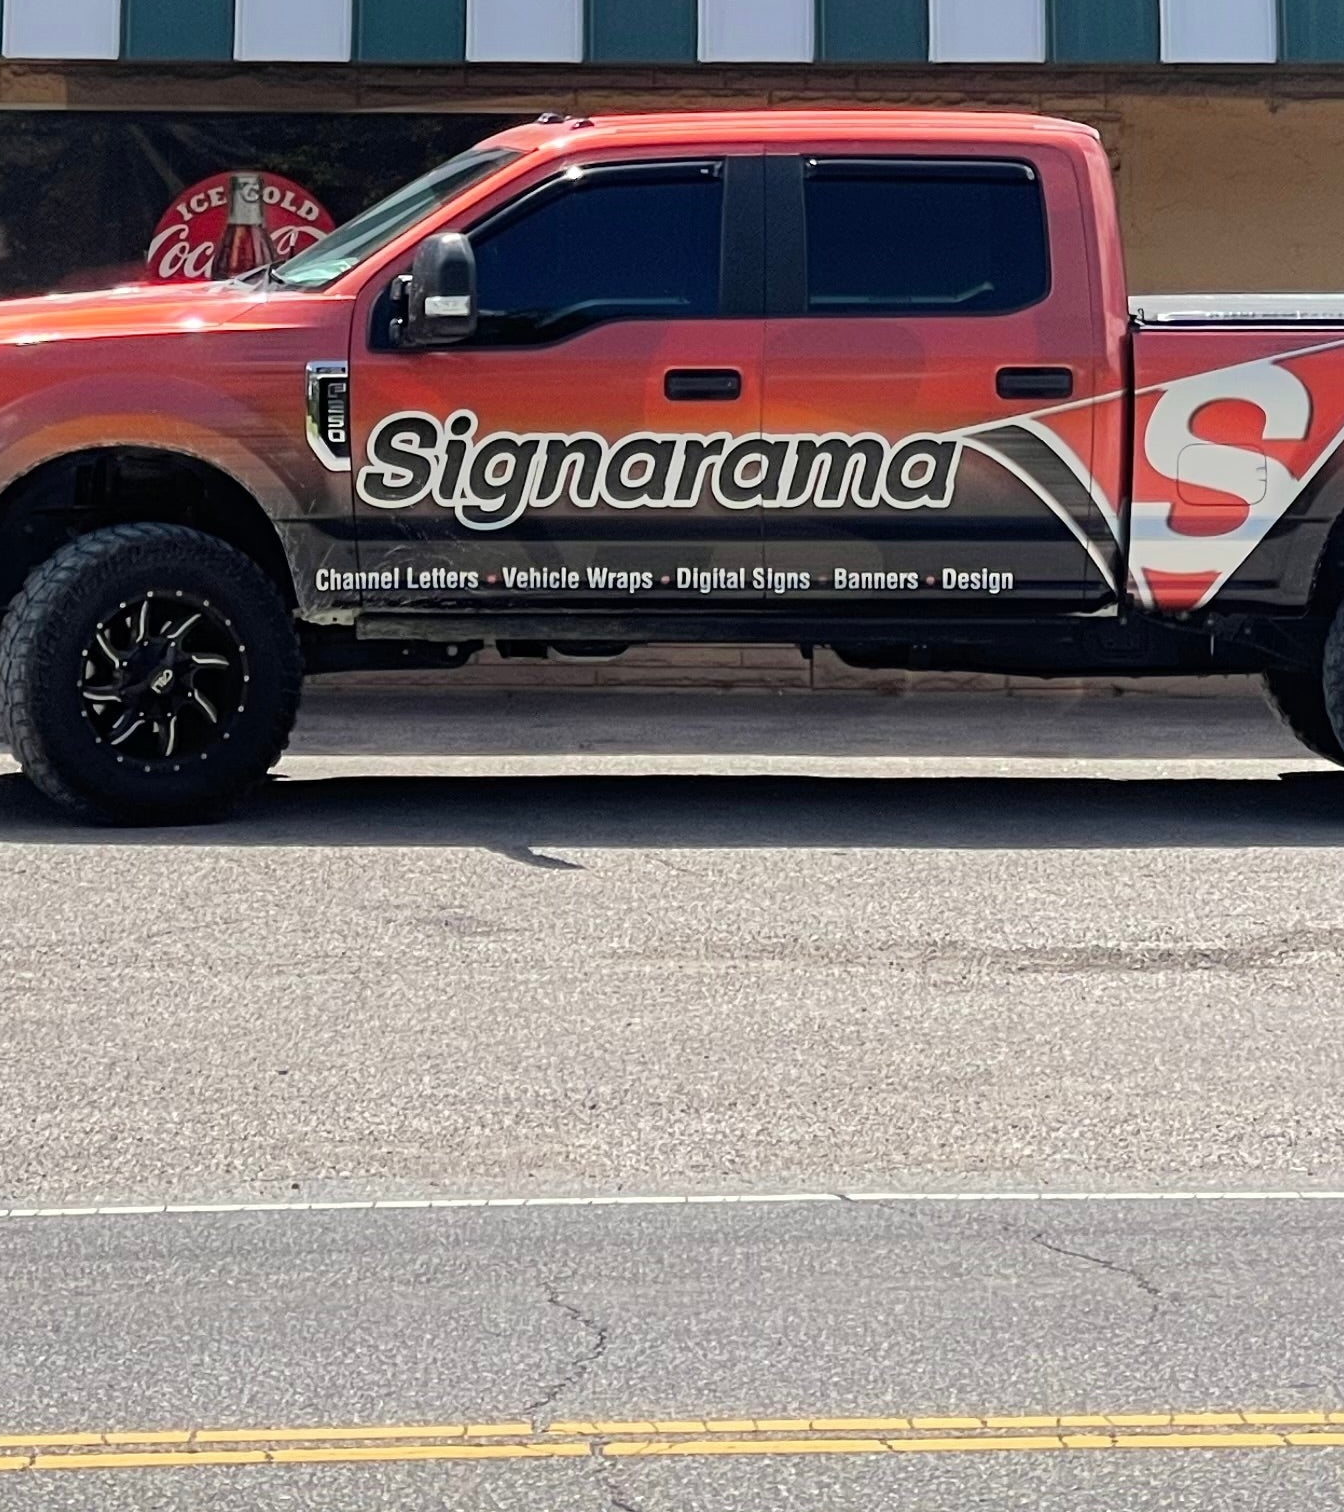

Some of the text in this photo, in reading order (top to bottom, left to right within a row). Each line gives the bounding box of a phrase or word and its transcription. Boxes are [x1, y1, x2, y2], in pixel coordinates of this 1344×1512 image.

[176, 184, 319, 222] ICE COLD
[356, 408, 964, 531] Signarama
[315, 567, 1014, 595] Channel Letters Vehicle Wraps Digital Signs Banners Design
